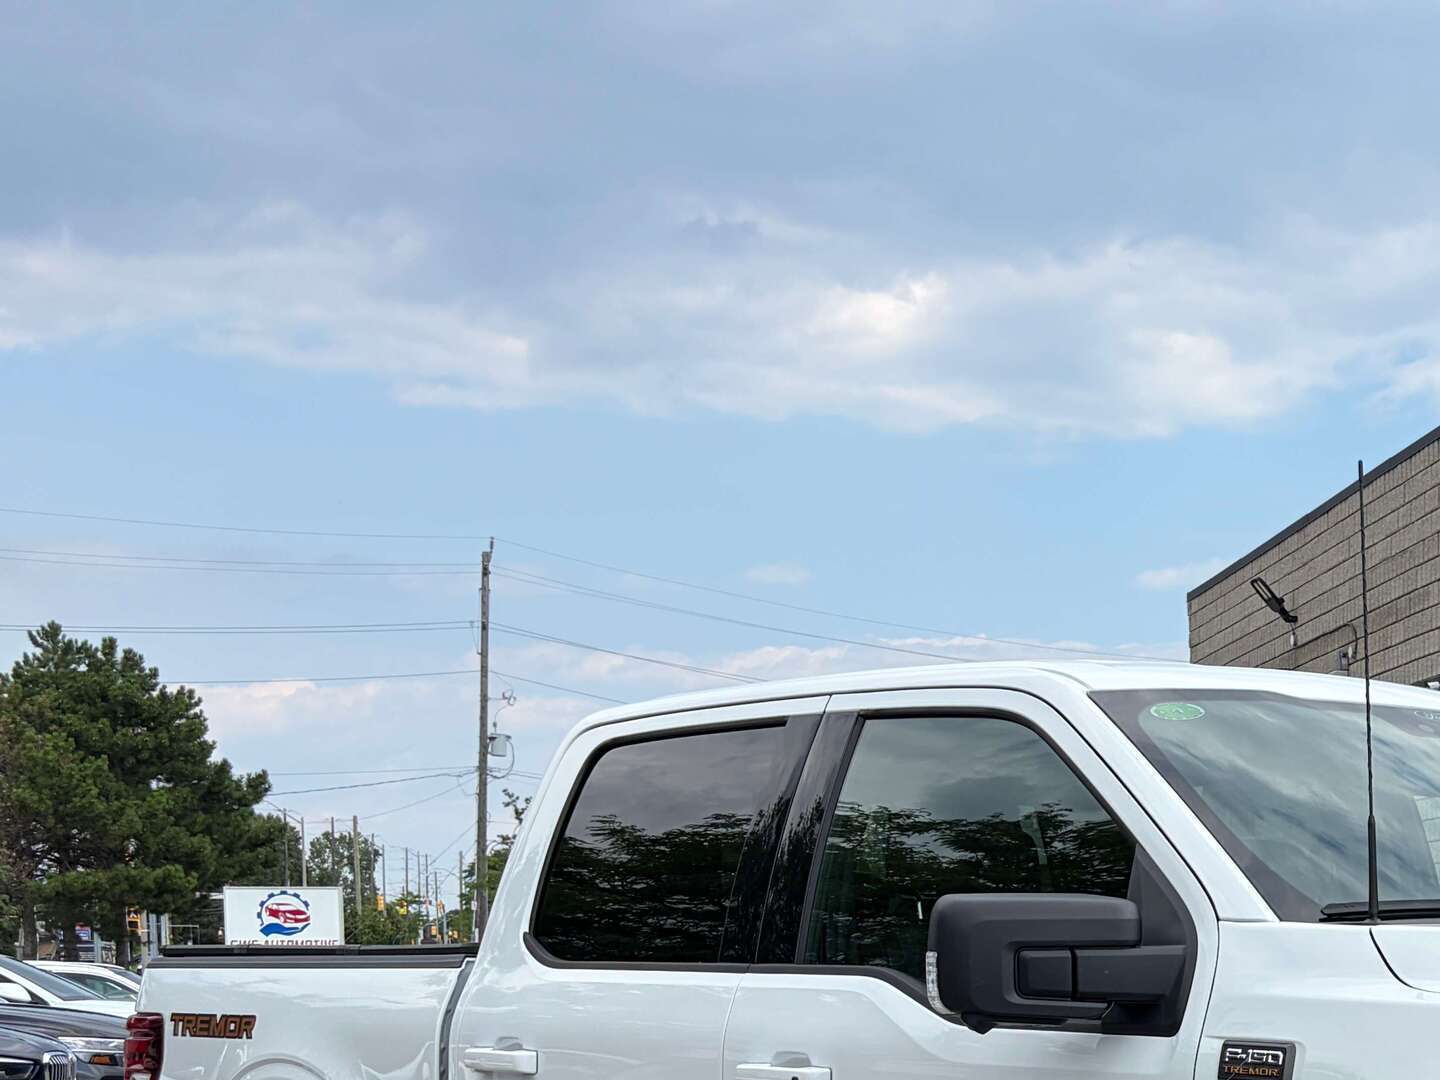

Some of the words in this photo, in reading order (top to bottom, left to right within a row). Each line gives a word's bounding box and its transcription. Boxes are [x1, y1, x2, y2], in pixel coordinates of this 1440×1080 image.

[170, 1012, 257, 1040] TREMOR
[1225, 1047, 1284, 1065] F-150
[1223, 1064, 1280, 1077] TREMOR
